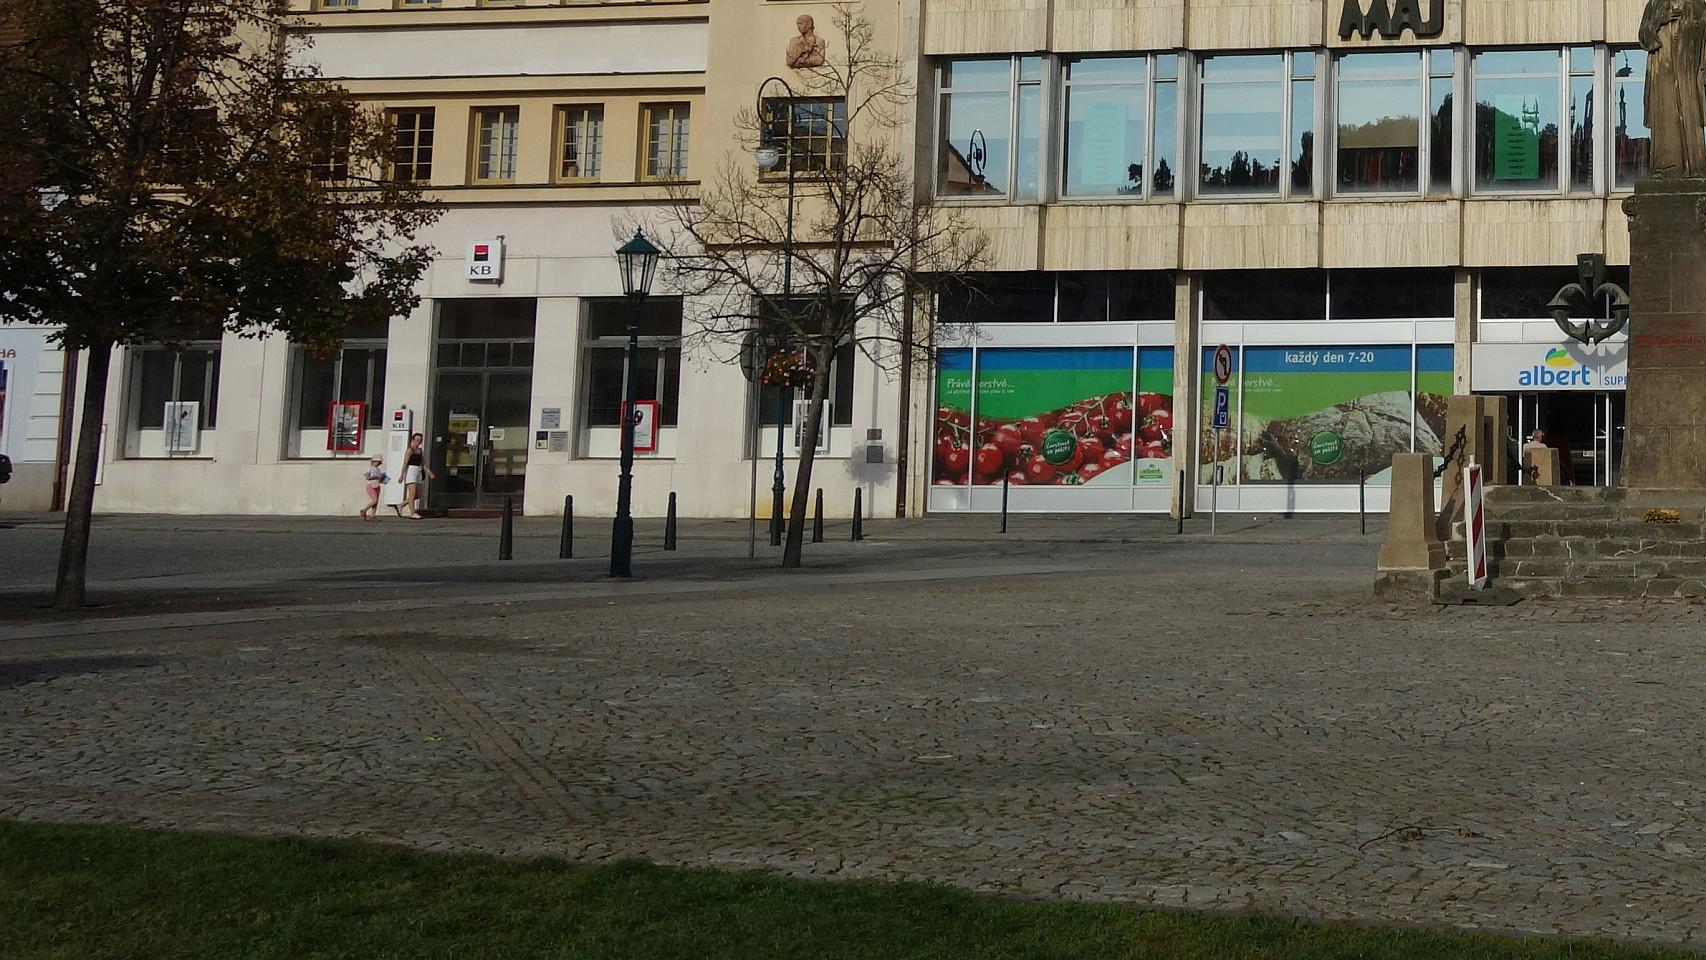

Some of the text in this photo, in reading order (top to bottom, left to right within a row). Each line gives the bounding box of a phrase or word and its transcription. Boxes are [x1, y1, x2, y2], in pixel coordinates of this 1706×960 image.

[470, 265, 492, 275] KB
[1285, 351, 1374, 366] každý den 7-20
[1518, 365, 1591, 386] albert
[1217, 392, 1226, 415] P
